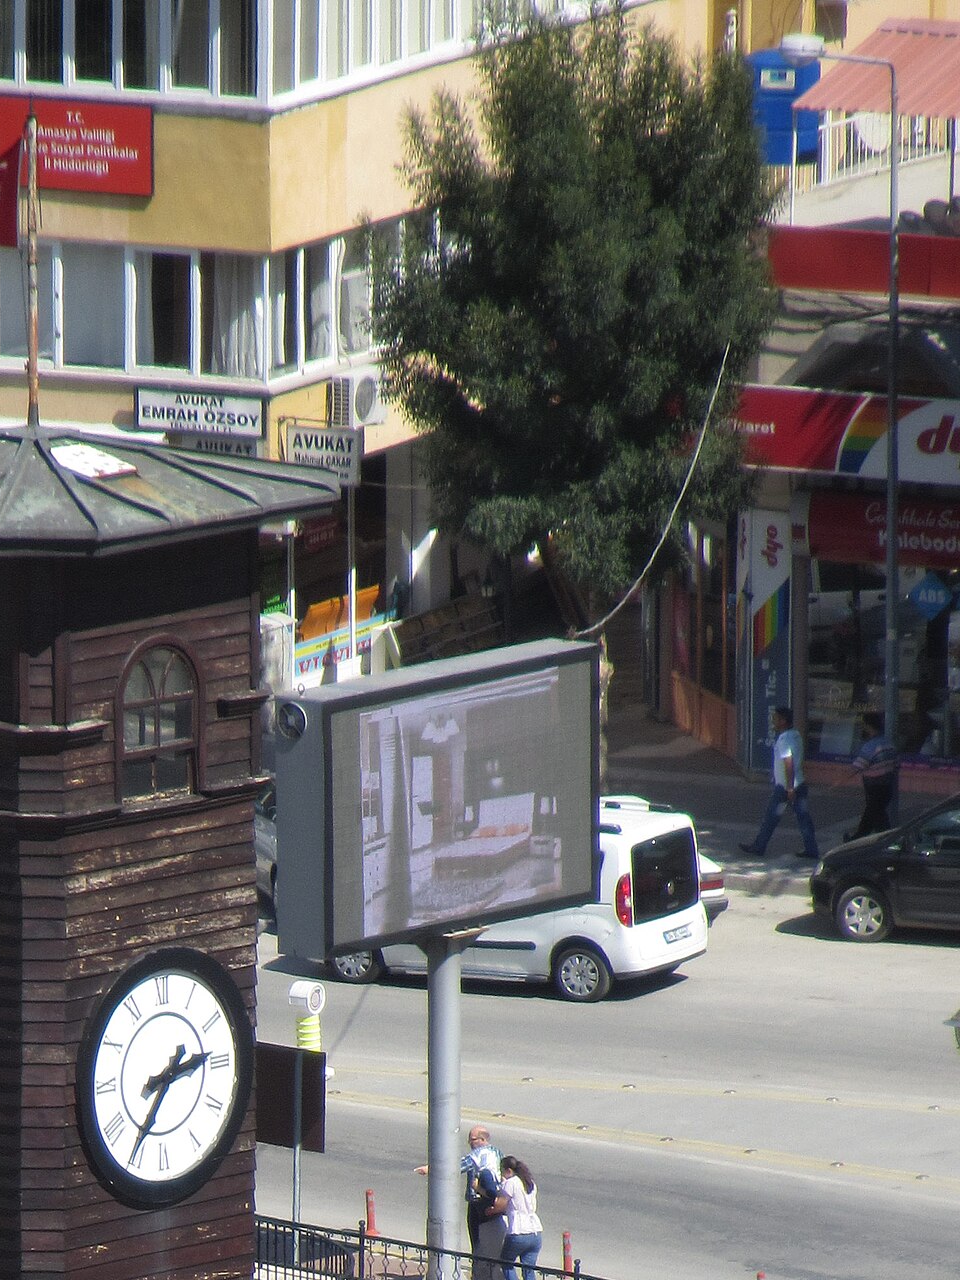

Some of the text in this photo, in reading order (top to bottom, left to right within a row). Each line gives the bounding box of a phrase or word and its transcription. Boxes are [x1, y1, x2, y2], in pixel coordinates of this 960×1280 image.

[37, 126, 77, 143] Amasya
[51, 142, 84, 158] Sosyal
[87, 144, 139, 161] Politikalar
[175, 394, 226, 408] AVUKAT
[142, 405, 198, 422] EMRAH
[203, 407, 260, 428] ÖZSOY
[293, 432, 354, 453] AVUKAT
